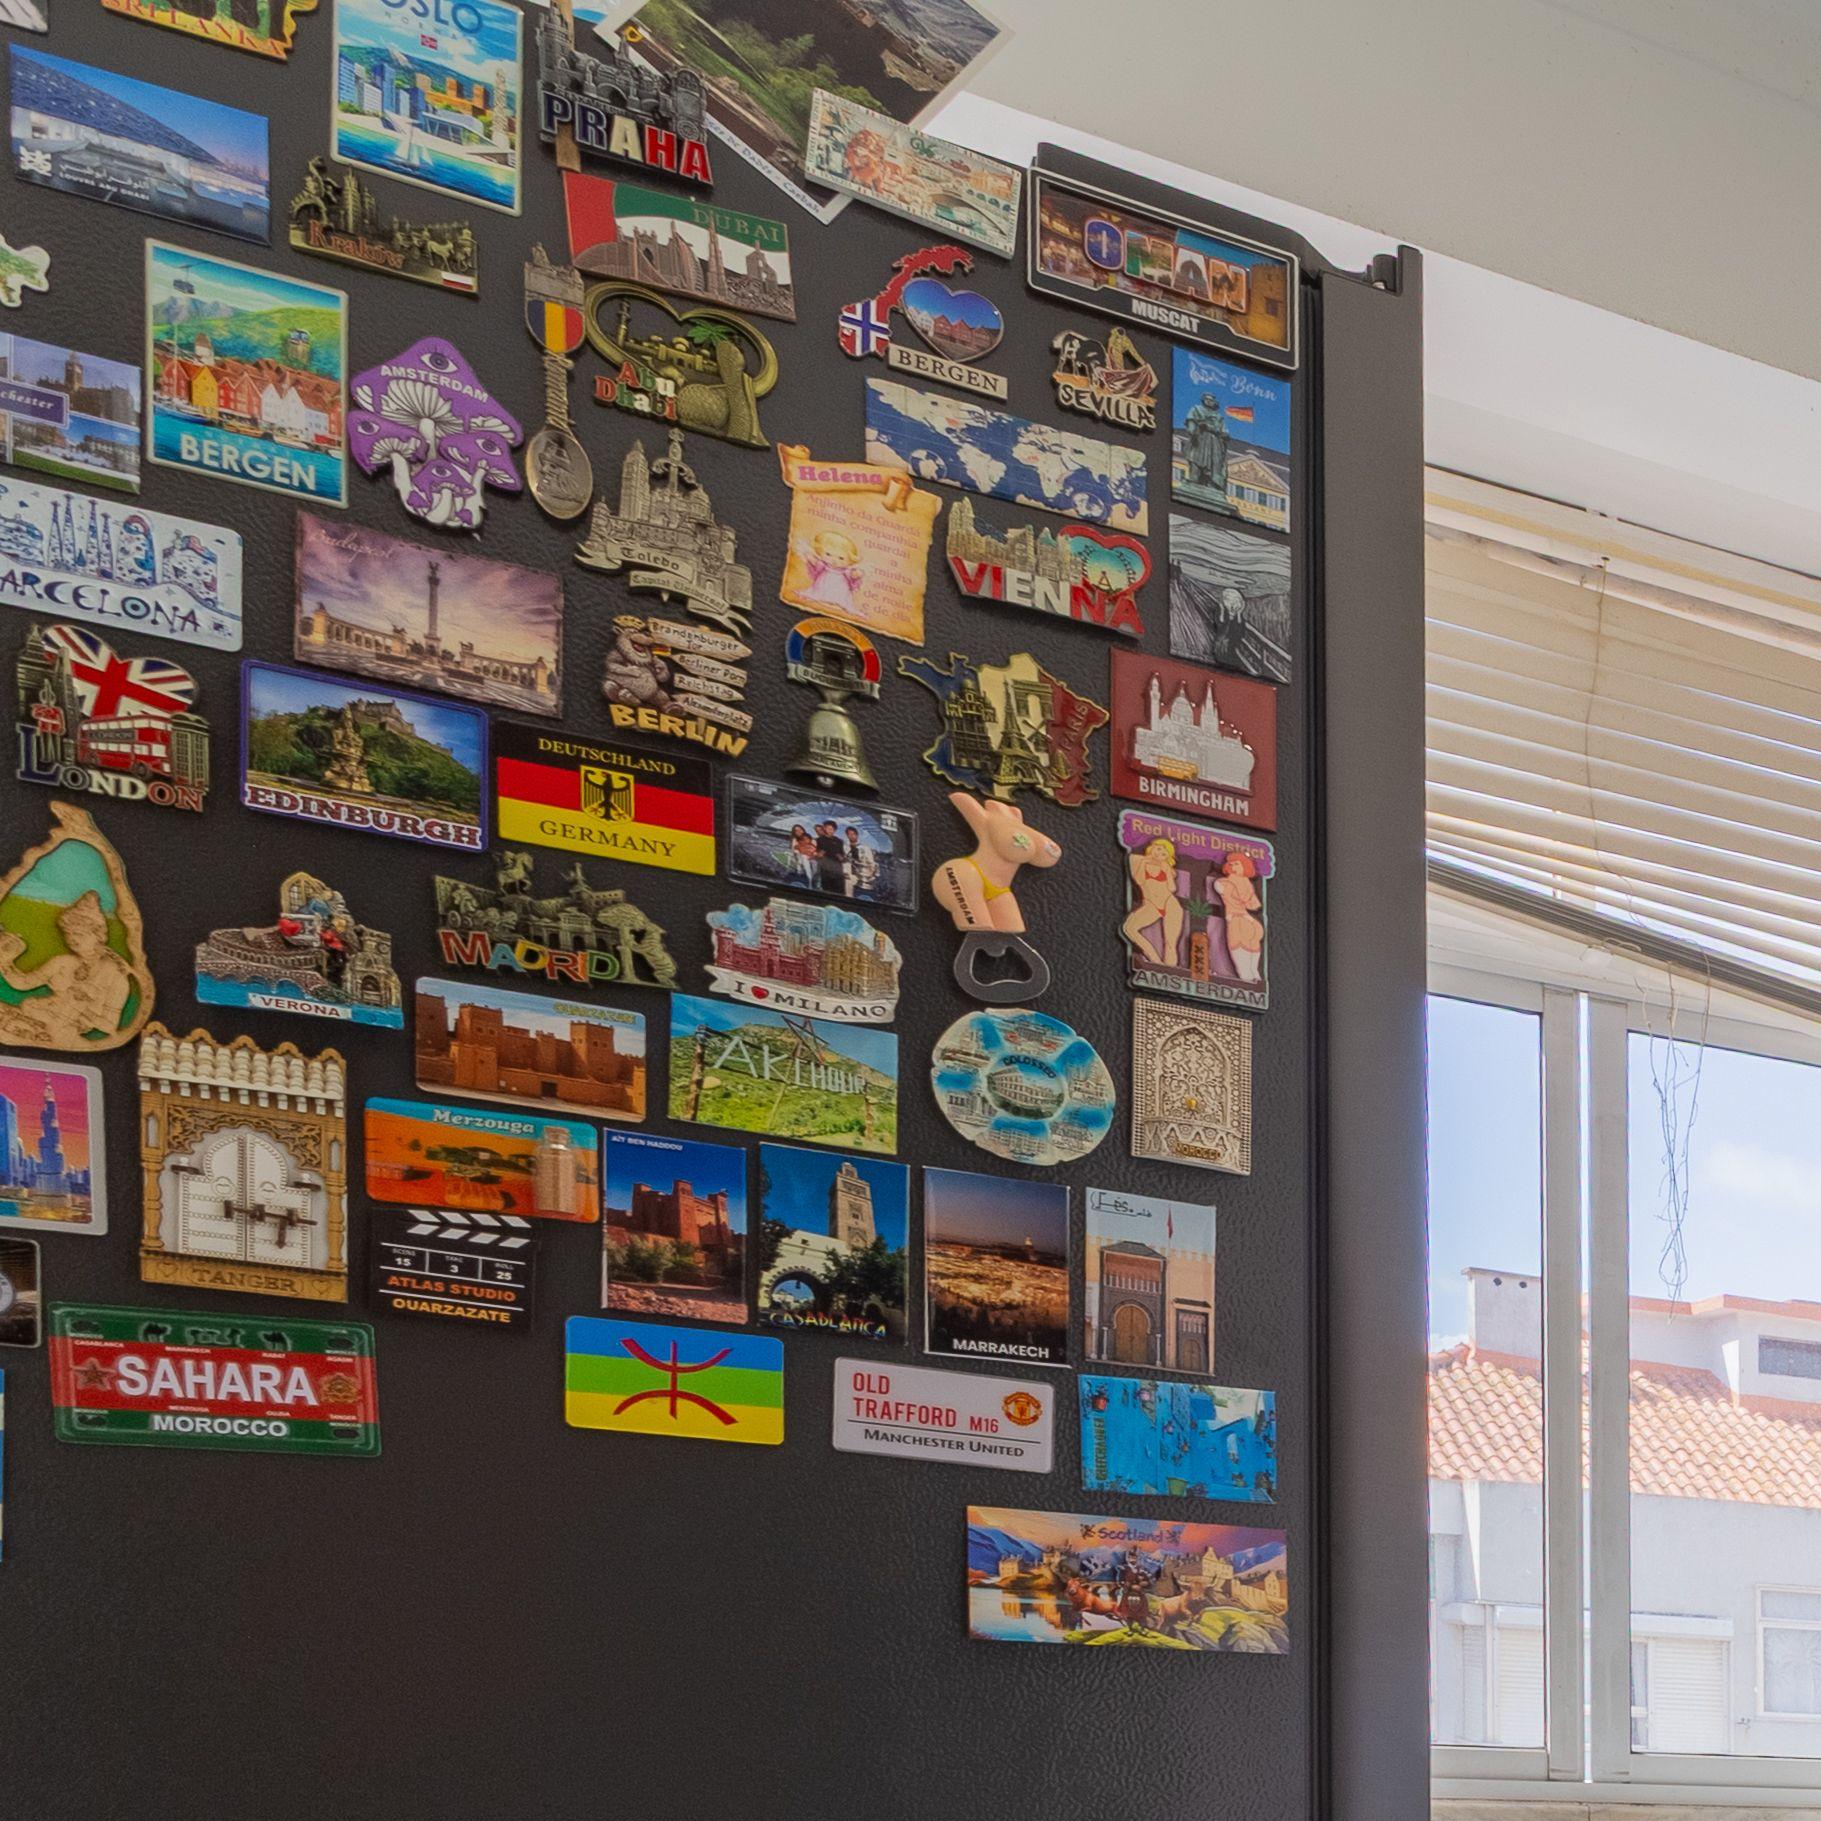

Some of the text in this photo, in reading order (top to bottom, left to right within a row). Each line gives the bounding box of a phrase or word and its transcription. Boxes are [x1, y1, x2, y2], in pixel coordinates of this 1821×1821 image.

[170, 8, 288, 60] LANKA
[380, 0, 483, 35] SLO
[541, 90, 714, 185] PRAHA
[693, 207, 780, 243] DUBAI
[308, 219, 404, 268] Kraków
[1084, 216, 1249, 314] OMAN
[1131, 298, 1201, 334] MUSCAT
[380, 364, 489, 403] AMSTERDAM
[615, 360, 677, 398] Abu
[897, 348, 1000, 393] BERGEN
[1230, 374, 1278, 402] Bonn
[594, 374, 678, 421] Dhabi
[1059, 383, 1157, 428] SEVILLA
[179, 431, 317, 491] BERGEN
[797, 465, 883, 486] Helena
[806, 493, 855, 515] Anjinho
[857, 509, 873, 522] da
[308, 528, 397, 562] Budapest
[807, 506, 919, 550] minha companhia
[621, 549, 681, 572] Toledo
[874, 566, 913, 586] minha
[863, 587, 913, 612] de noite
[873, 578, 904, 596] alma
[950, 555, 1146, 634] VIENNA
[651, 621, 741, 652] Brandenburger
[686, 638, 704, 651] Tor
[678, 654, 722, 676] Berliner
[677, 676, 736, 699] Reichstag
[608, 702, 750, 759] BERLIN
[683, 697, 750, 728] Alexanderplatz
[1062, 701, 1091, 751] PARIS
[15, 722, 205, 813] LONDON
[537, 736, 676, 776] DEUTSCHLAND
[1138, 776, 1250, 816] BIRMINGHAM
[245, 784, 481, 848] EDINBURGH
[538, 818, 677, 858] GERMANY
[1131, 818, 1266, 861] Red Light District
[945, 865, 976, 926] AMSTERDAM
[437, 929, 621, 983] MADRID
[733, 980, 888, 1018] I MILANO
[1134, 969, 1268, 1007] AMSTERDAM
[260, 996, 341, 1018] VERONA
[431, 1107, 536, 1136] Merzouga
[627, 1136, 646, 1148] BEN
[191, 1268, 298, 1294] TANGER
[395, 1256, 513, 1282] 15 3 25
[386, 1274, 517, 1303] ATLAS STUDIO
[391, 1297, 512, 1324] OUARZAZATE
[952, 1337, 1050, 1360] MARRAKECH
[116, 1354, 319, 1407] SAHARA
[852, 1372, 891, 1396] OLD
[152, 1414, 289, 1438] MOROCCO
[852, 1396, 1000, 1434] TRAFFORD M16
[1097, 1526, 1165, 1543] Scotland
